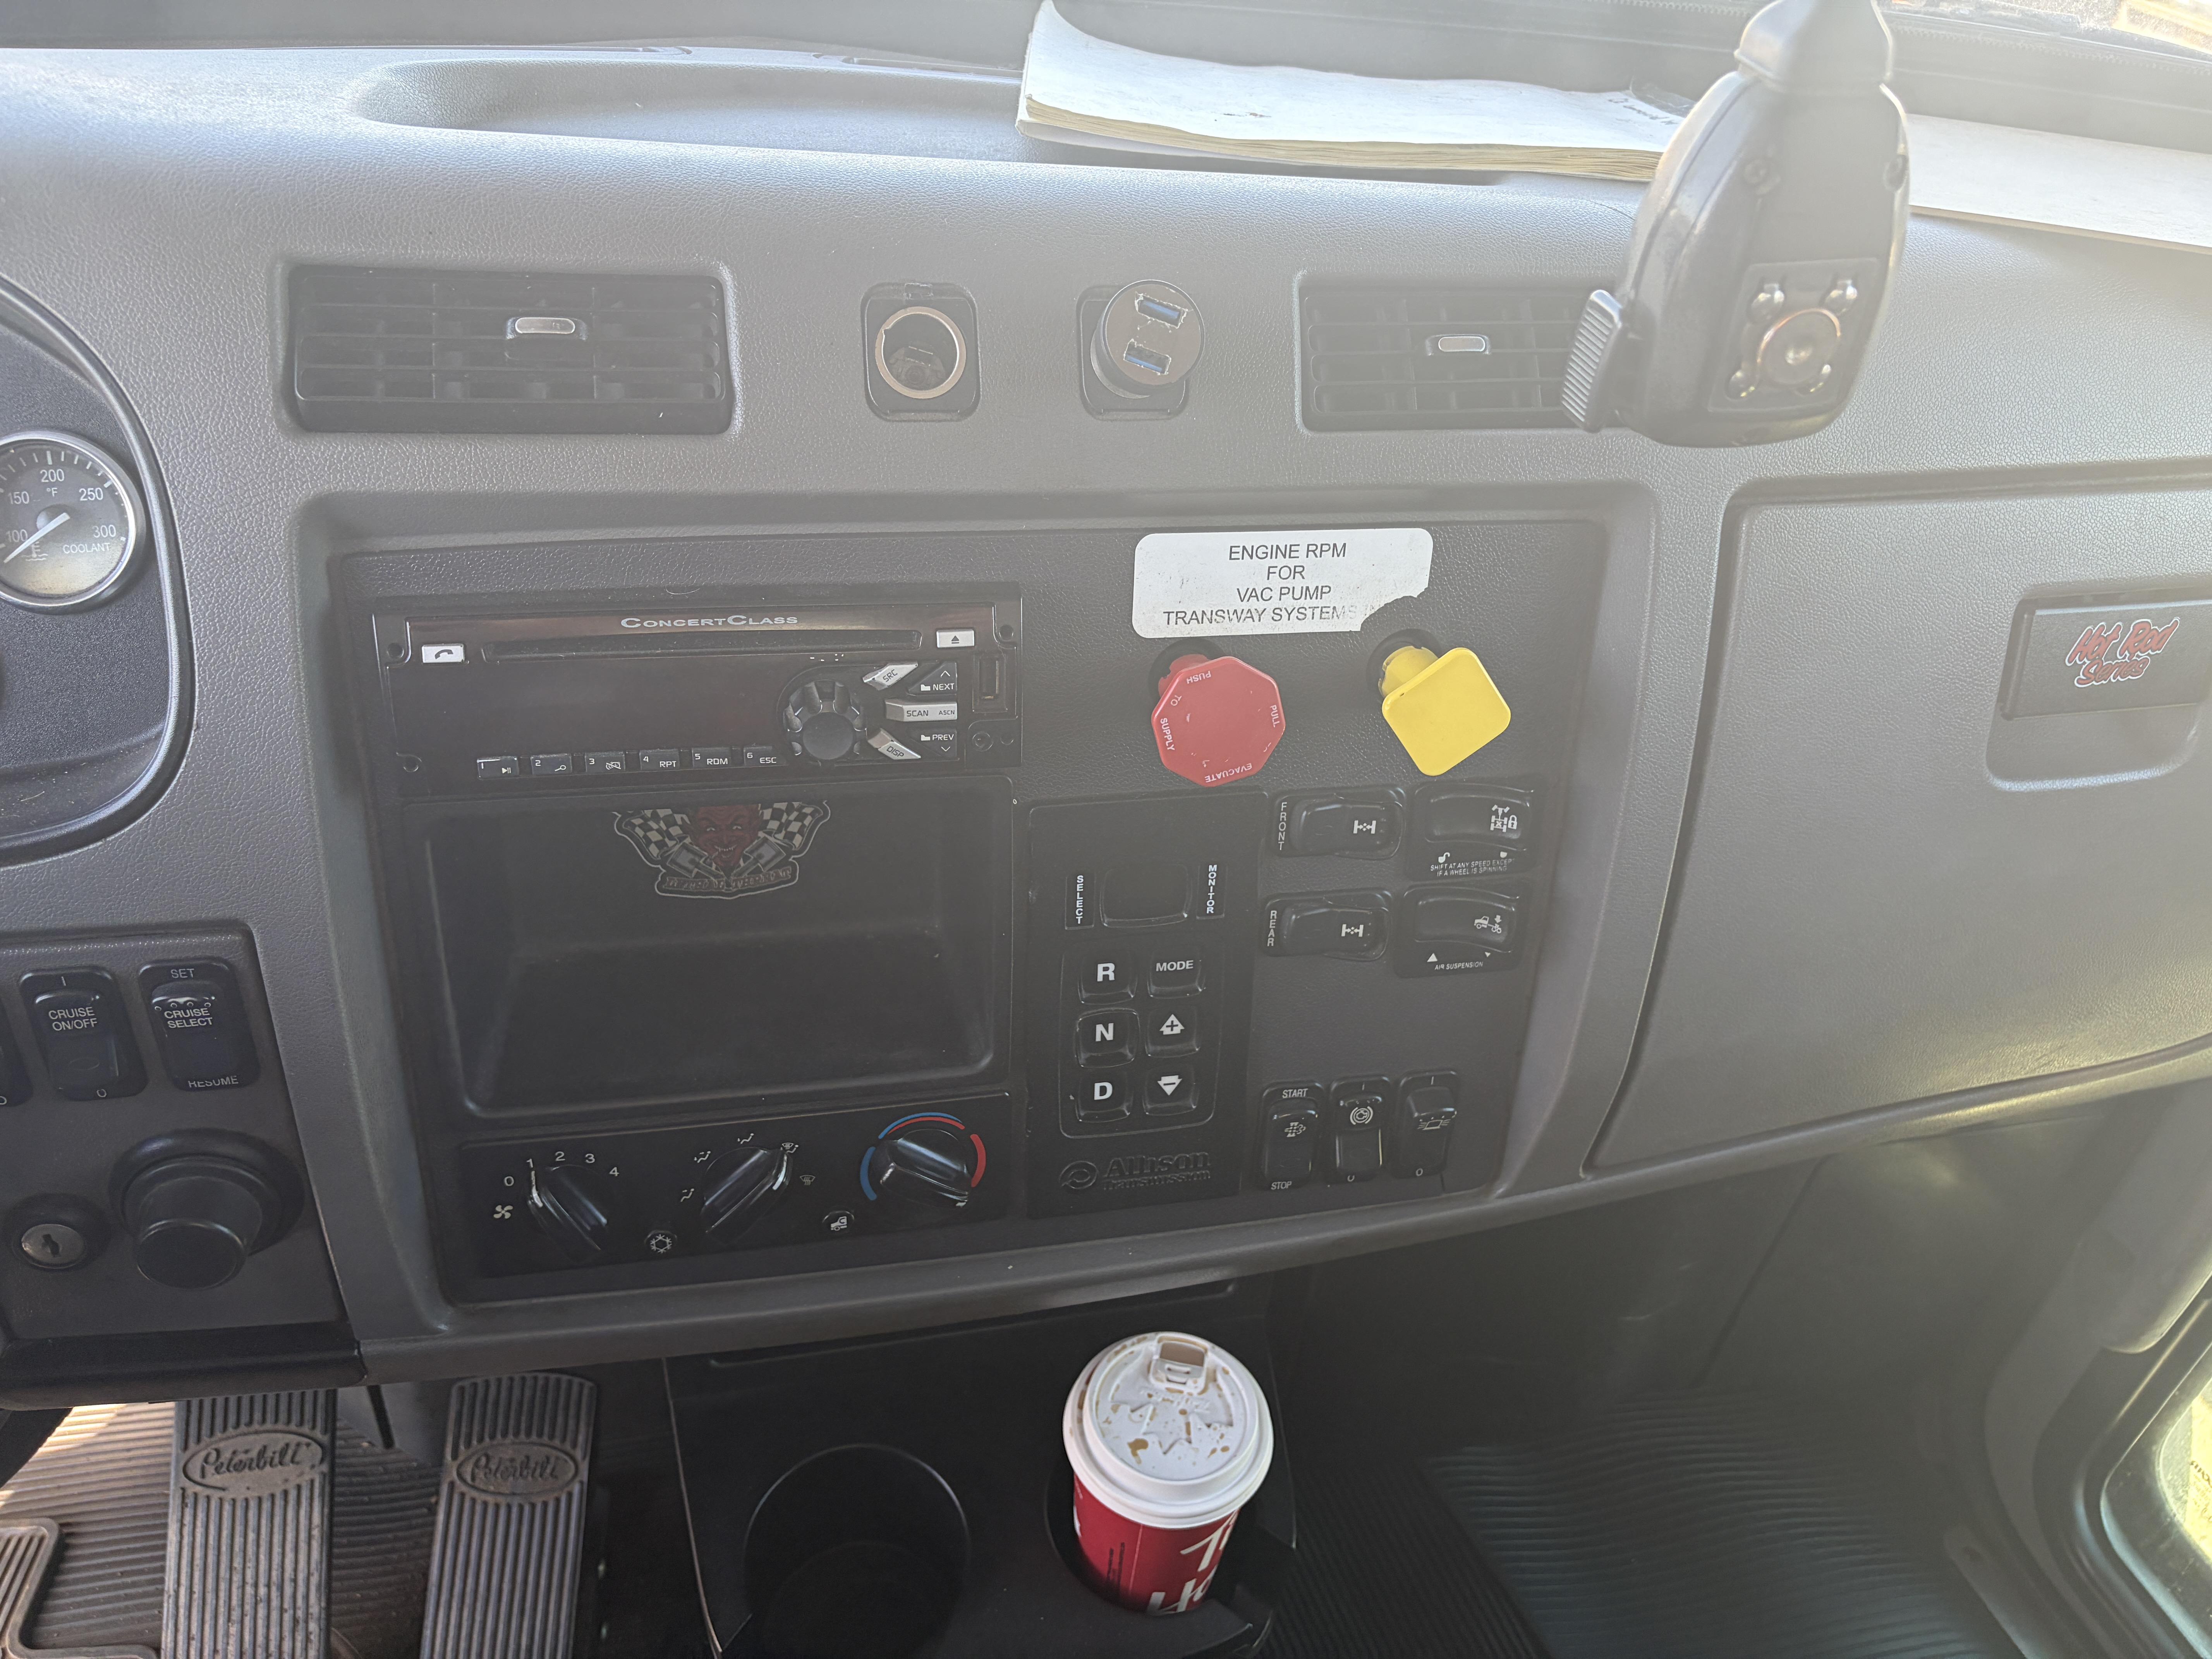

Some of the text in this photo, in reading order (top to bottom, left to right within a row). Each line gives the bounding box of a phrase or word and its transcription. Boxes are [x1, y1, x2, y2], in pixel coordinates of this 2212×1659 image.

[40, 469, 65, 482] 200
[9, 491, 30, 504] 150
[79, 487, 103, 501] 250
[5, 529, 28, 543] 100
[93, 525, 116, 538] 300
[63, 543, 110, 554] COOLANT
[1229, 543, 1346, 560] ENGINE RPM
[1267, 565, 1305, 580] FOR
[1237, 585, 1331, 602] VAC PUMP
[1163, 608, 1267, 625] TRANSWAY
[2066, 617, 2180, 665] Hot Rod
[883, 669, 898, 682] SRC
[2075, 656, 2150, 687] Series
[1160, 670, 1212, 751] PUSH TO SUPPLY
[1270, 704, 1280, 728] PULL
[886, 745, 905, 757] DISP
[1205, 763, 1252, 783] EVACUATE
[1278, 802, 1287, 850] FRONT
[1431, 863, 1448, 871] SHIFT
[1471, 860, 1491, 868] SPEED
[1206, 864, 1218, 914] MONITOR
[1075, 875, 1084, 924] SELECT
[1267, 910, 1277, 946] REAR
[1156, 960, 1194, 972] MODE
[1446, 961, 1484, 970] SUSPENSION
[170, 968, 195, 979] SET
[1096, 963, 1115, 982] R
[48, 1006, 95, 1020] CRUISE
[164, 1008, 210, 1019] CRUISE
[52, 1018, 98, 1031] ON/OFF
[167, 1017, 213, 1029] SELECT
[1095, 1022, 1114, 1042] N
[1094, 1082, 1113, 1100] D
[1282, 1088, 1309, 1099] START
[555, 1151, 566, 1161] 2
[585, 1153, 596, 1163] 3
[526, 1158, 534, 1168] 1
[609, 1167, 620, 1176] 4
[504, 1176, 515, 1187] 0
[1271, 1181, 1292, 1190] STOP
[199, 1441, 304, 1479] Peterbilt
